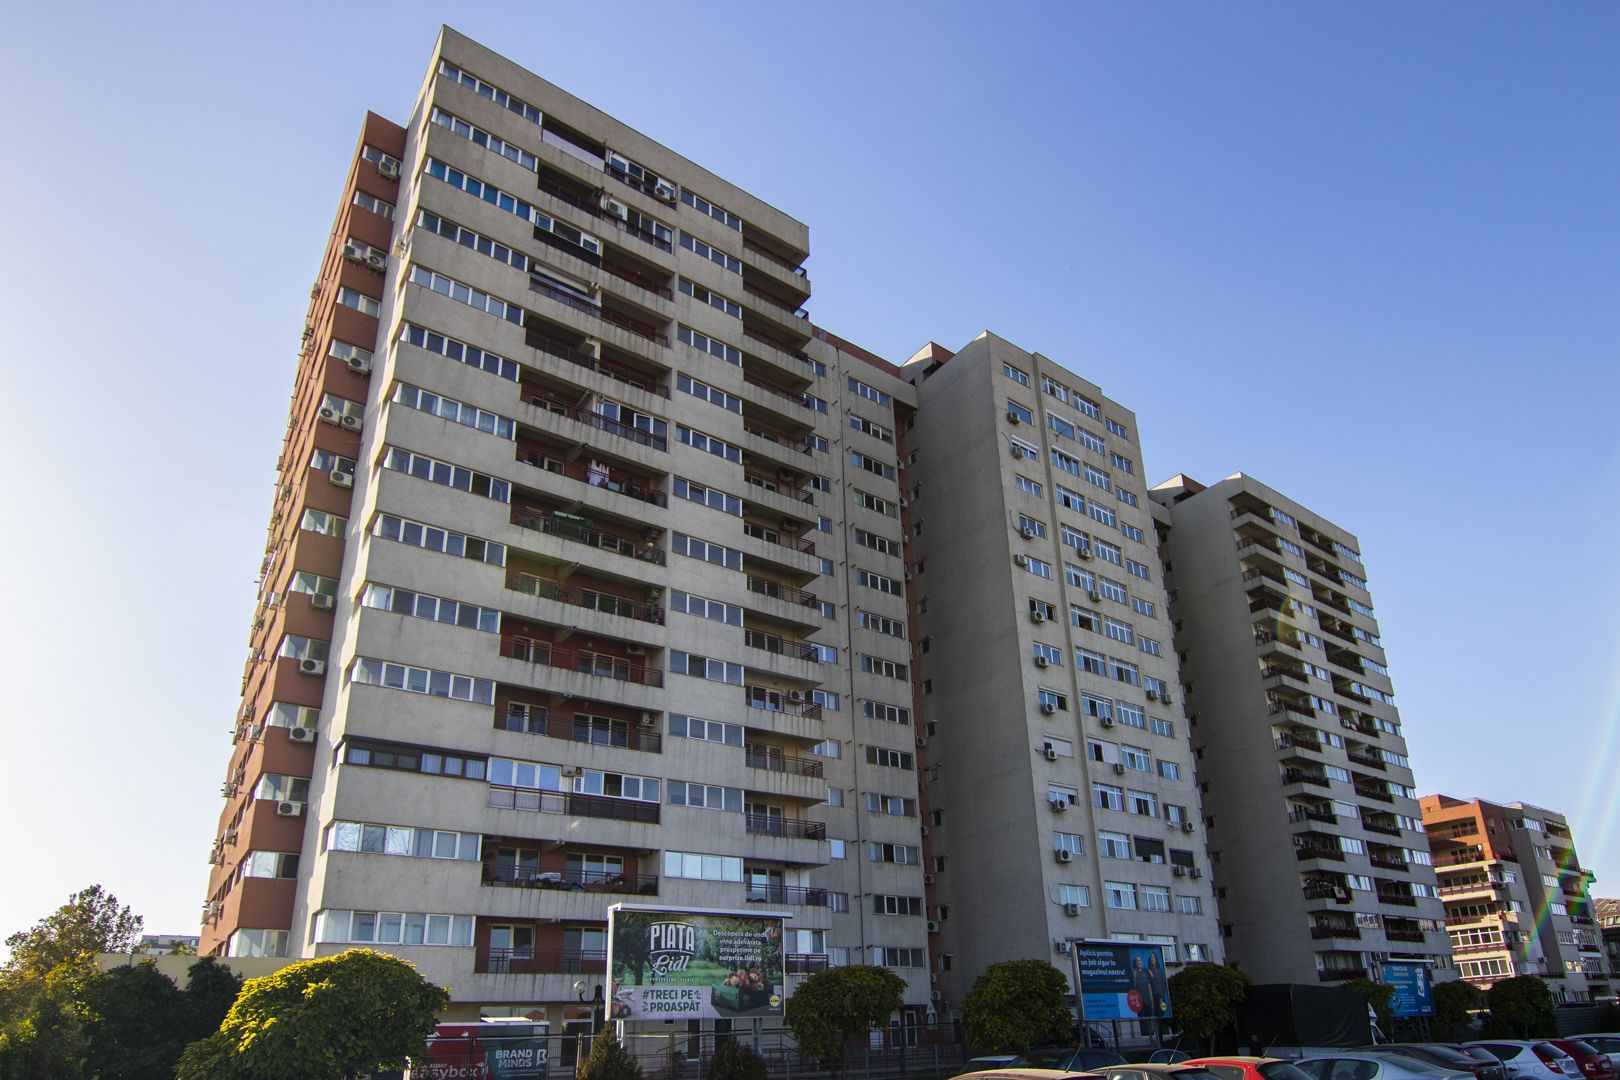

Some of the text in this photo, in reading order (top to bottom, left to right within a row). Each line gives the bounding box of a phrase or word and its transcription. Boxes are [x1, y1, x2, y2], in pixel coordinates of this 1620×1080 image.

[652, 955, 690, 976] Lidl
[643, 989, 693, 1000] #TRECI PE
[650, 1000, 700, 1012] PROASPĂT
[496, 1049, 532, 1058] BRAND
[498, 1058, 532, 1068] MINDS
